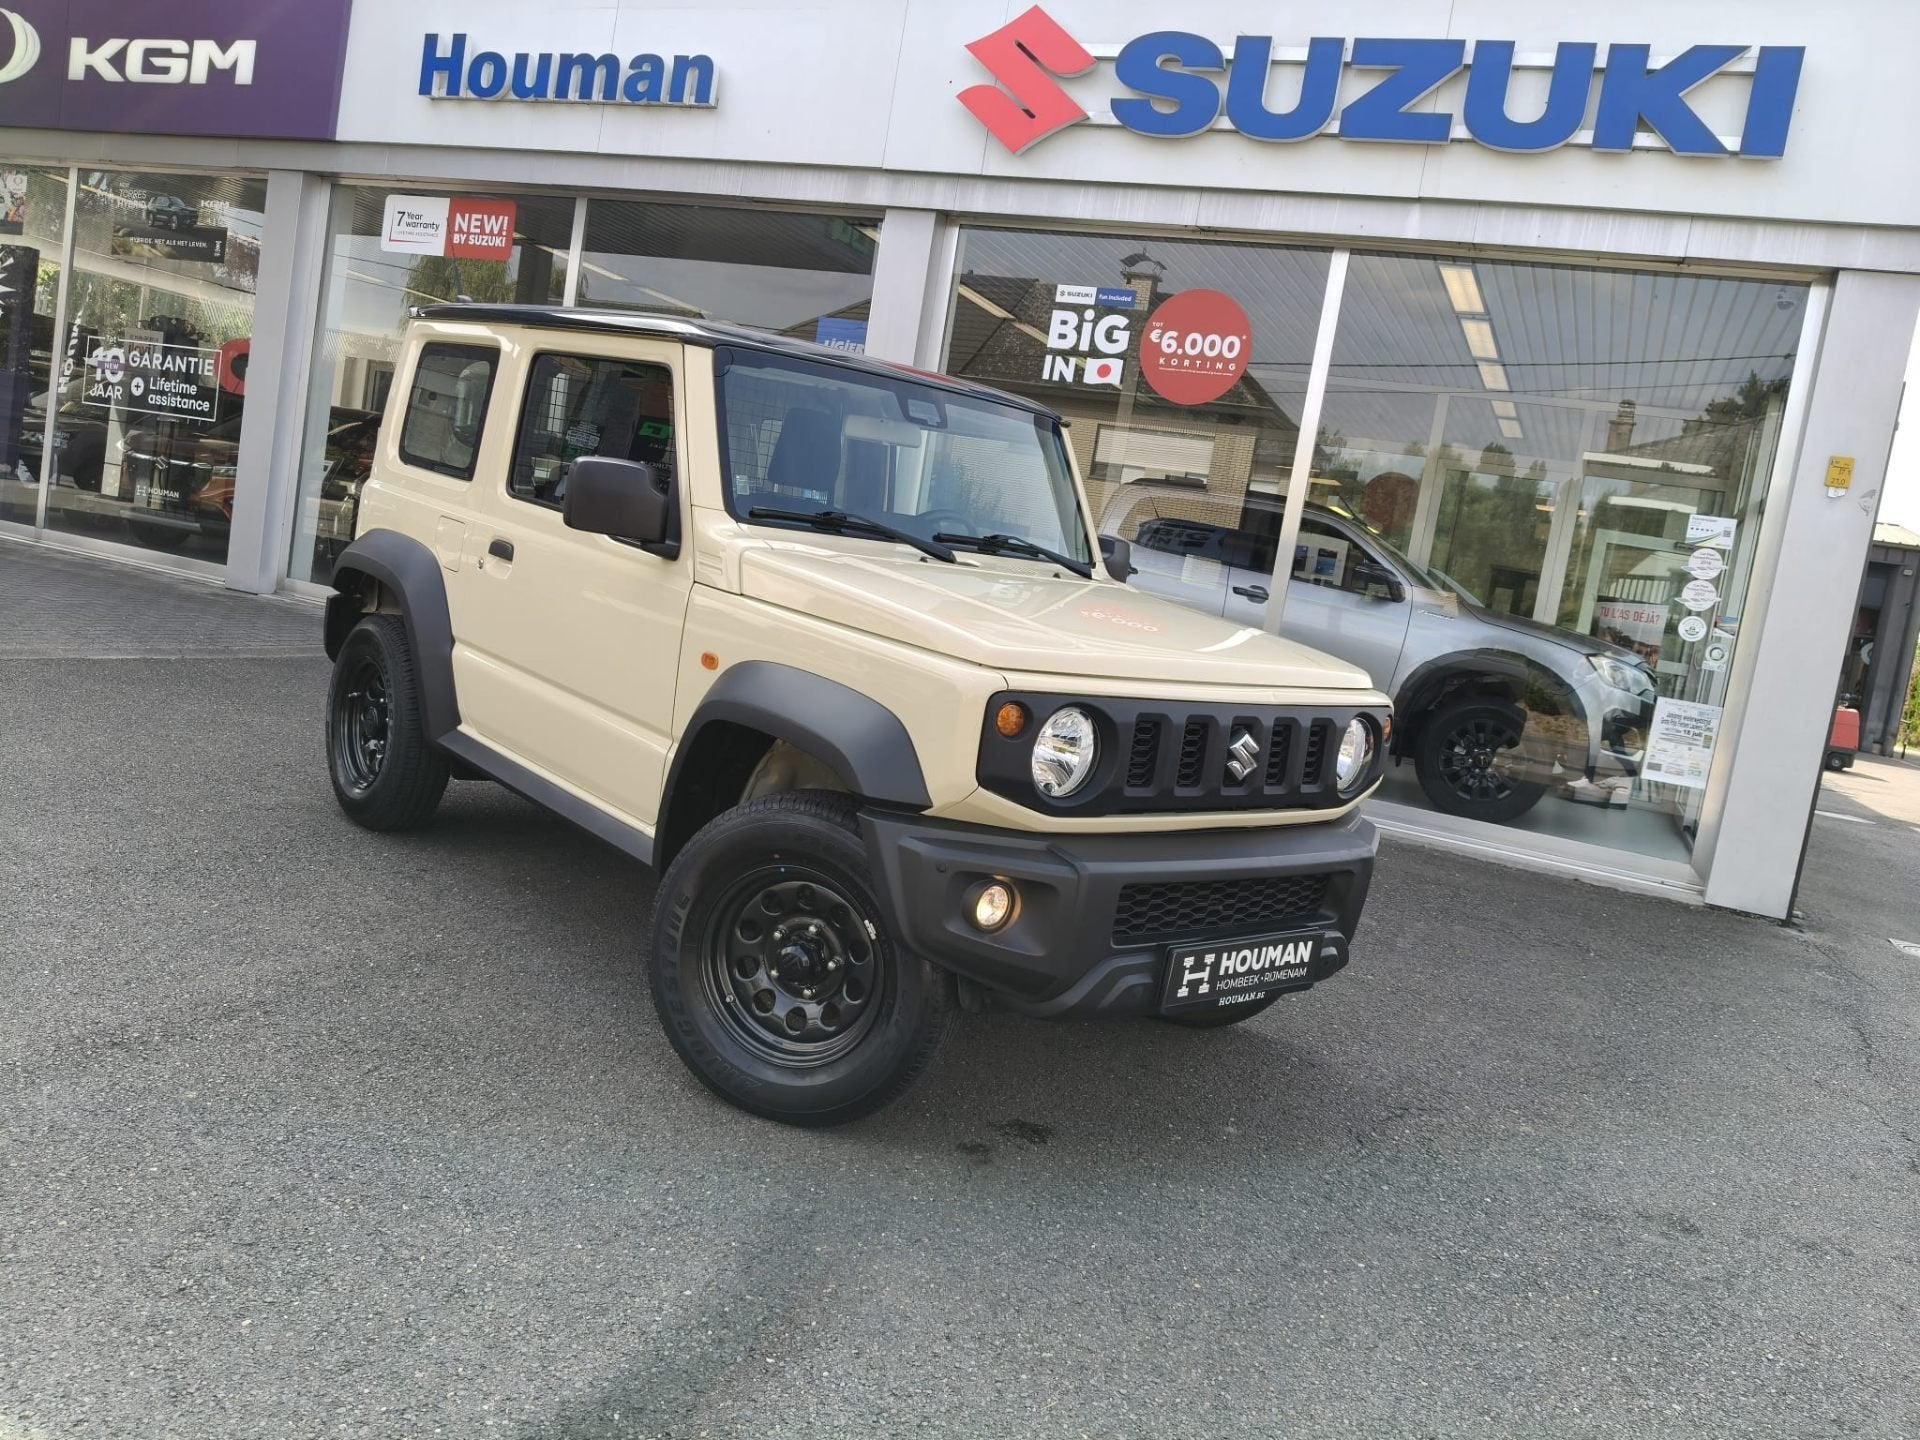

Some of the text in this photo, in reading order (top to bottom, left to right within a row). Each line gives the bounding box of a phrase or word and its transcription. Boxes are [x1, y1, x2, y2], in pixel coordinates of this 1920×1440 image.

[68, 37, 257, 85] KGM
[418, 33, 717, 106] Houman
[1110, 30, 1806, 160] SUZUKI
[396, 211, 424, 227] 7 Year
[405, 221, 441, 231] warranty
[454, 213, 509, 236] NEW!
[453, 233, 507, 248] BY SUZUKI
[1066, 291, 1093, 299] SUZUKI
[92, 346, 215, 384] 10 GARANTIE
[104, 362, 119, 370] NEW
[1042, 354, 1076, 383] IN
[1158, 356, 1237, 371] KORTING
[89, 383, 123, 400] JAAR
[149, 377, 198, 395] Lifetime
[147, 393, 211, 412] assistance
[148, 488, 180, 498] HOUMAN
[1600, 606, 1661, 625] TU L'AS DÉJÀ?
[1218, 940, 1314, 976] HOUMAN
[1216, 967, 1308, 991] HOMBEEK RIJMENAM
[1218, 991, 1266, 1007] HOUMAN.BE
